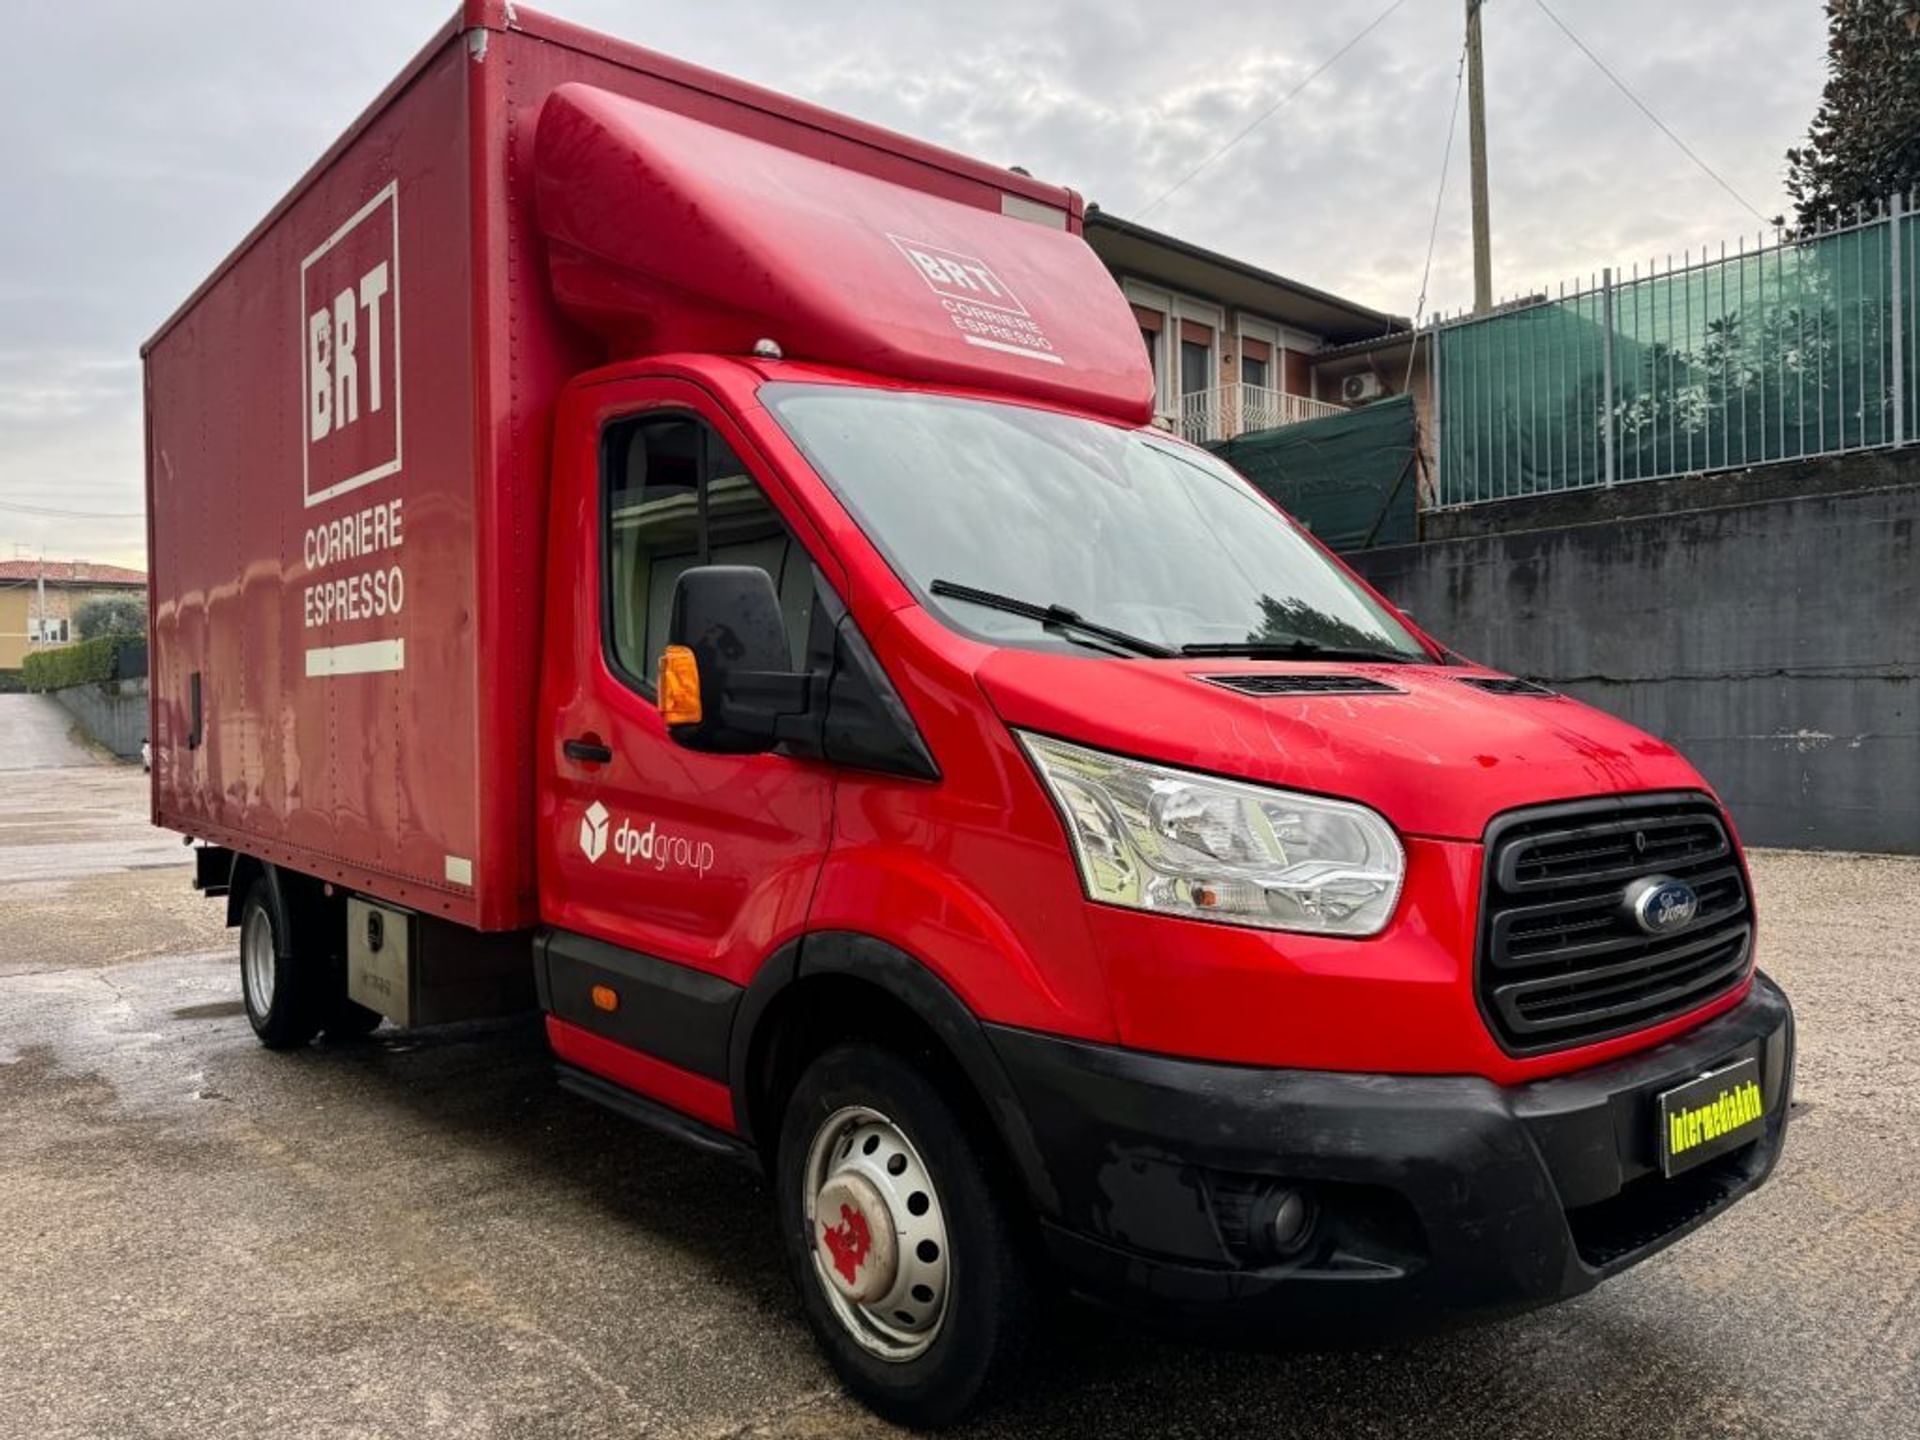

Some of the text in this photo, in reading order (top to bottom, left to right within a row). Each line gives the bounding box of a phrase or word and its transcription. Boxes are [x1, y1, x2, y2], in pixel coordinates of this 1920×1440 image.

[908, 249, 1001, 297] BRT
[941, 299, 1044, 336] CORRIERE
[950, 315, 1053, 351] ESPRESSO
[309, 260, 389, 442] BRT
[304, 497, 403, 571] CORRIERE
[304, 565, 404, 627] ESPRESSO
[614, 817, 714, 880] dpdgroup
[1658, 890, 1690, 924] Ford
